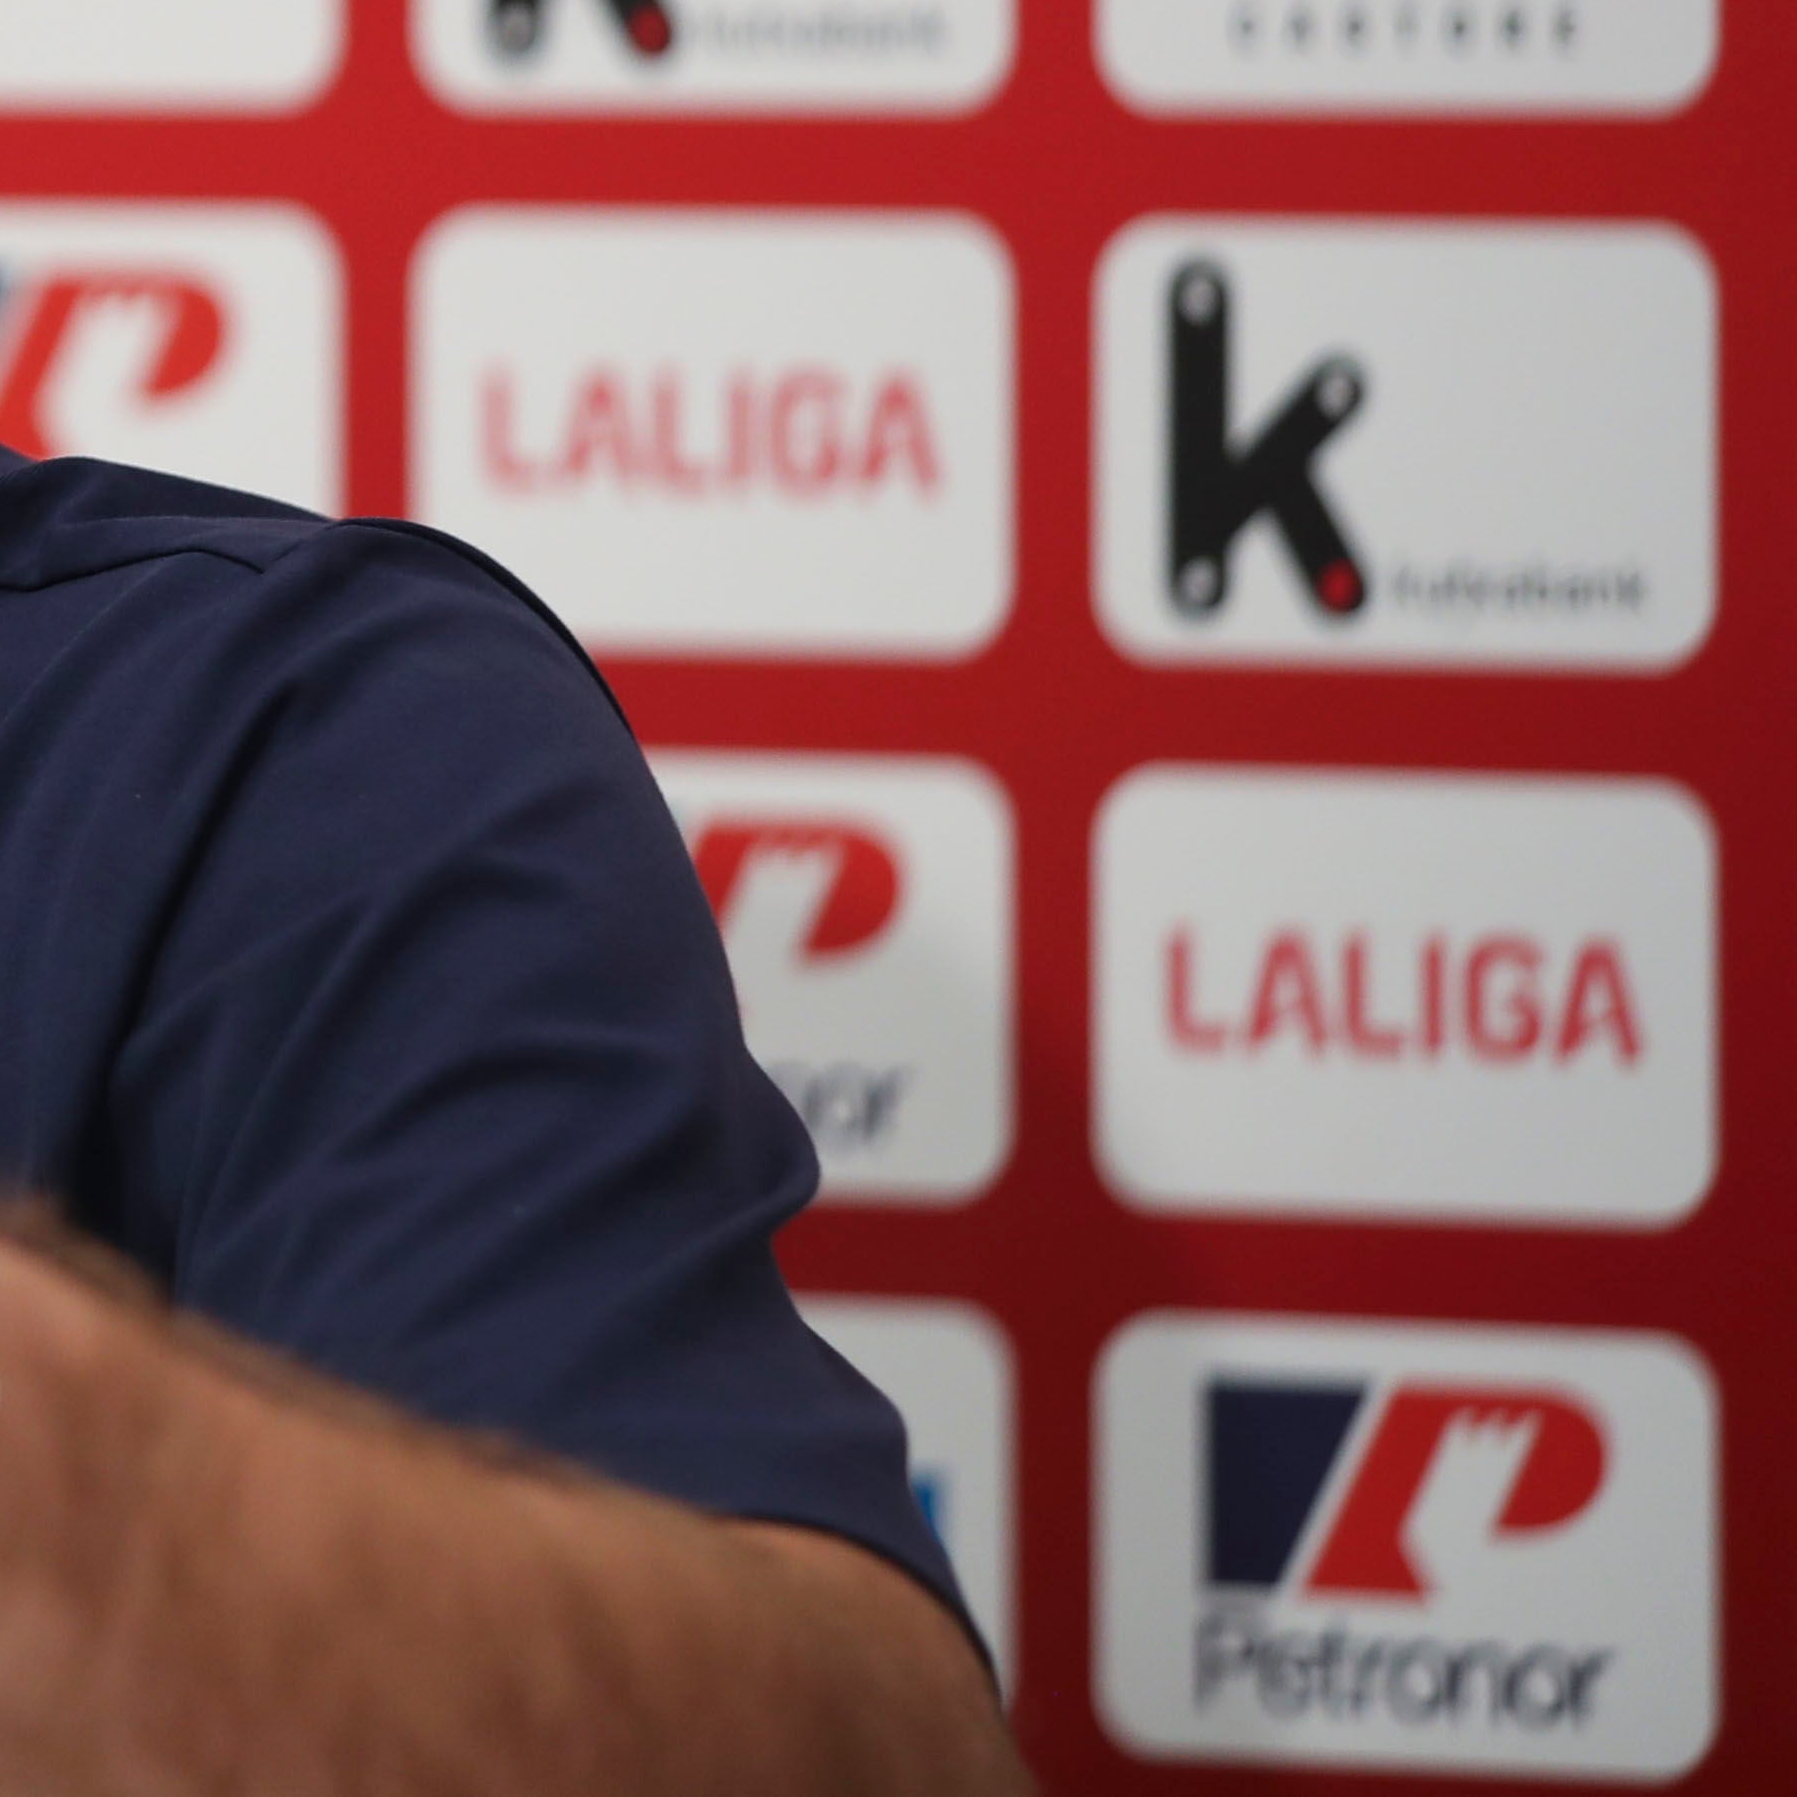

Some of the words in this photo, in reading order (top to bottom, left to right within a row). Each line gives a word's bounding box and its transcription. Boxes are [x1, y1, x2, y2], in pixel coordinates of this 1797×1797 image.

[1233, 0, 1581, 58] CASTORE
[481, 370, 942, 499] LALIGA
[1165, 928, 1643, 1068] LALIGA
[1193, 1614, 1612, 1729] Petronor
